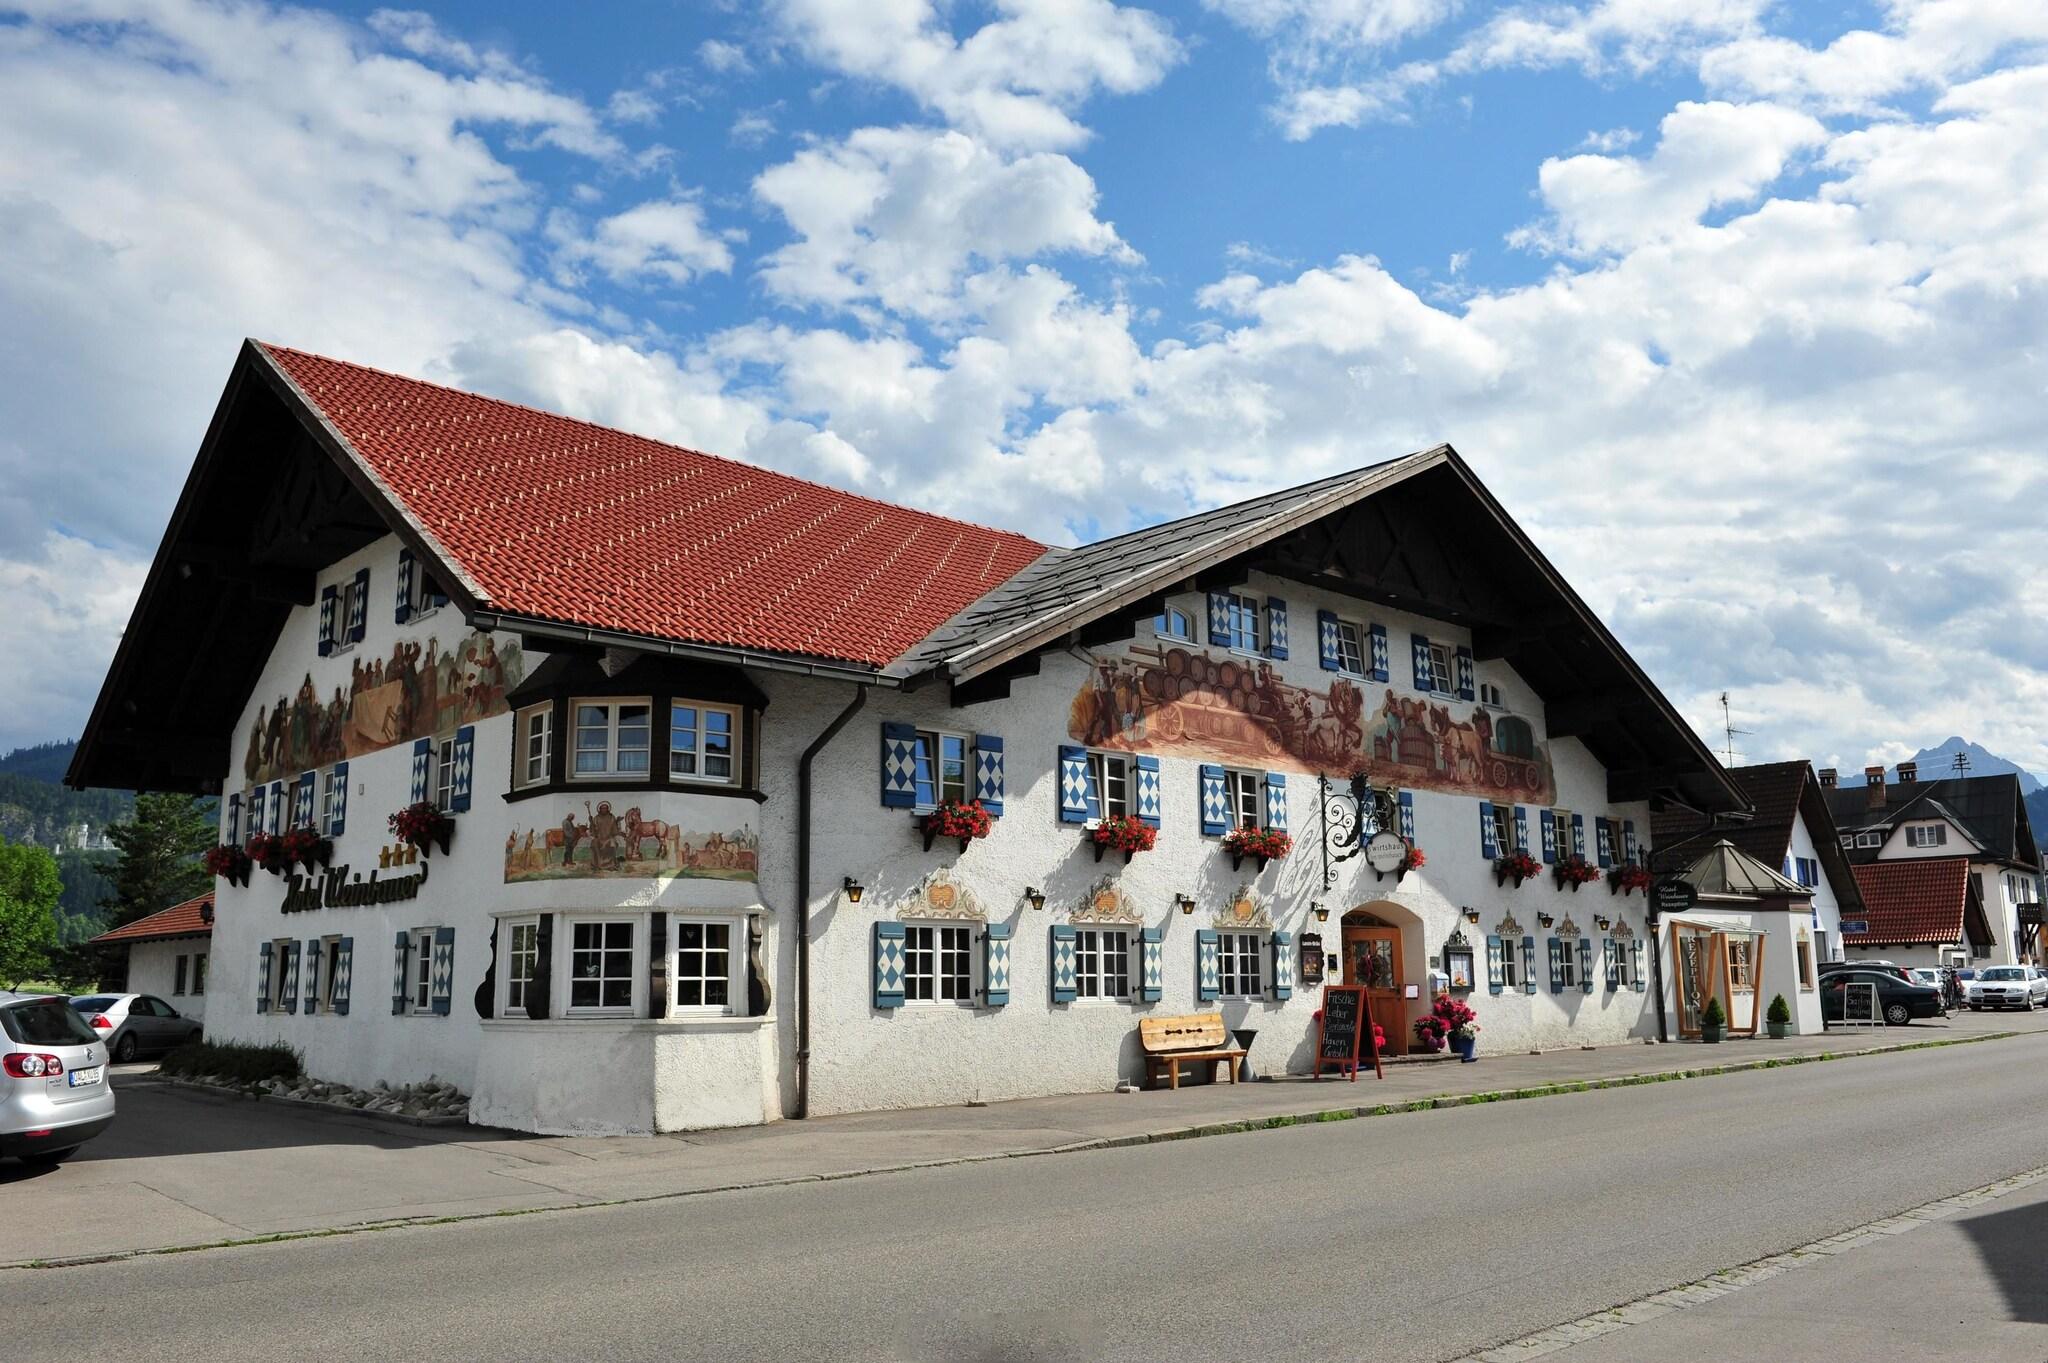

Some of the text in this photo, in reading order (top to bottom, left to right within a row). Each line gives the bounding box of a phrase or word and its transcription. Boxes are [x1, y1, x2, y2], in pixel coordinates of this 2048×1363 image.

[281, 861, 429, 914] Hotel Weinbauer
[1687, 935, 1701, 1008] REZEPTION
